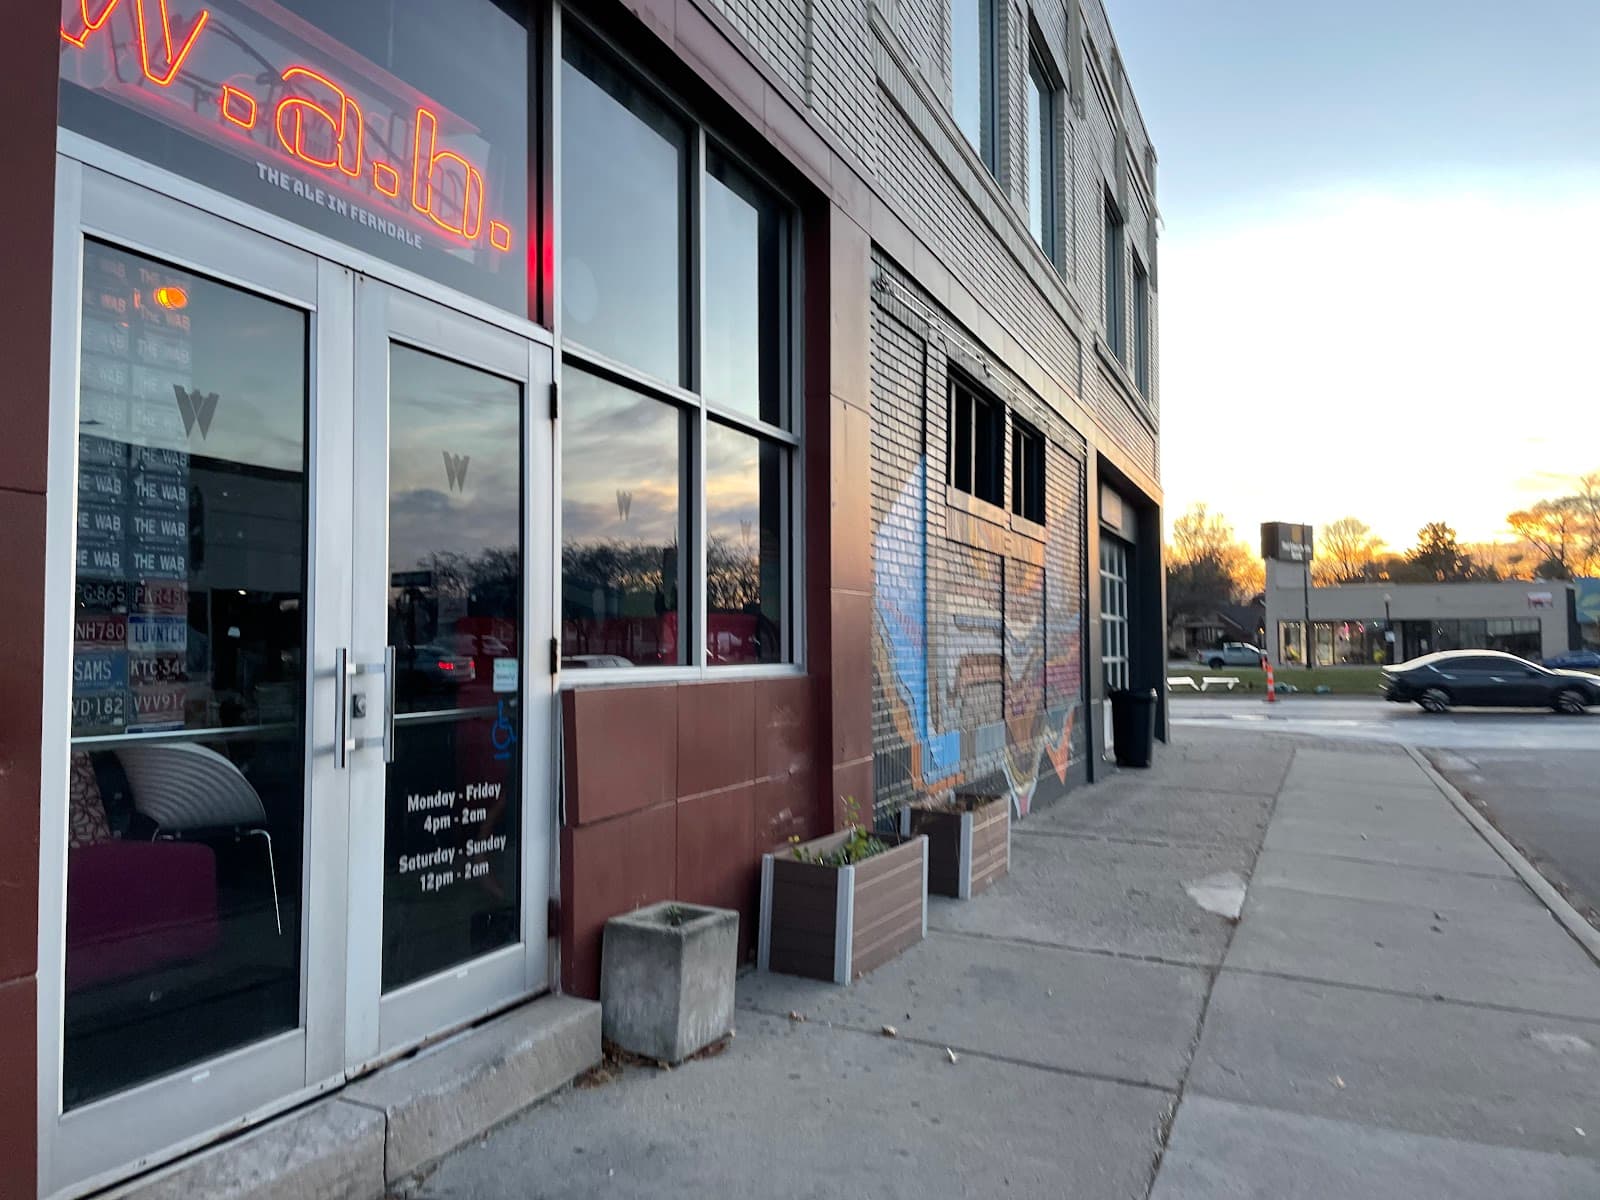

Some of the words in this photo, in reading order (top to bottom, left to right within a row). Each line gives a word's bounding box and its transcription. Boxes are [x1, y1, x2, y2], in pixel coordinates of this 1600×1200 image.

[256, 162, 290, 191] THE
[293, 180, 325, 207] ALE
[328, 194, 348, 216] IN
[350, 204, 423, 250] FERNDALE
[173, 384, 220, 440] W
[95, 475, 121, 495] WAB
[443, 451, 470, 492] W
[133, 479, 157, 498] THE
[161, 484, 186, 501] WAB
[95, 513, 121, 531] WAB
[134, 516, 156, 534] THE
[161, 519, 186, 537] WAB
[93, 551, 120, 568] WAB
[133, 552, 156, 569] THE
[159, 554, 185, 572] WAB
[408, 791, 455, 813] Monday
[466, 782, 501, 802] Friday
[424, 815, 451, 834] 4pm
[462, 807, 487, 825] 2am
[399, 847, 455, 873] Saturday
[466, 835, 507, 856] Sunday
[420, 872, 453, 892] 12pm
[464, 862, 489, 880] 2am
